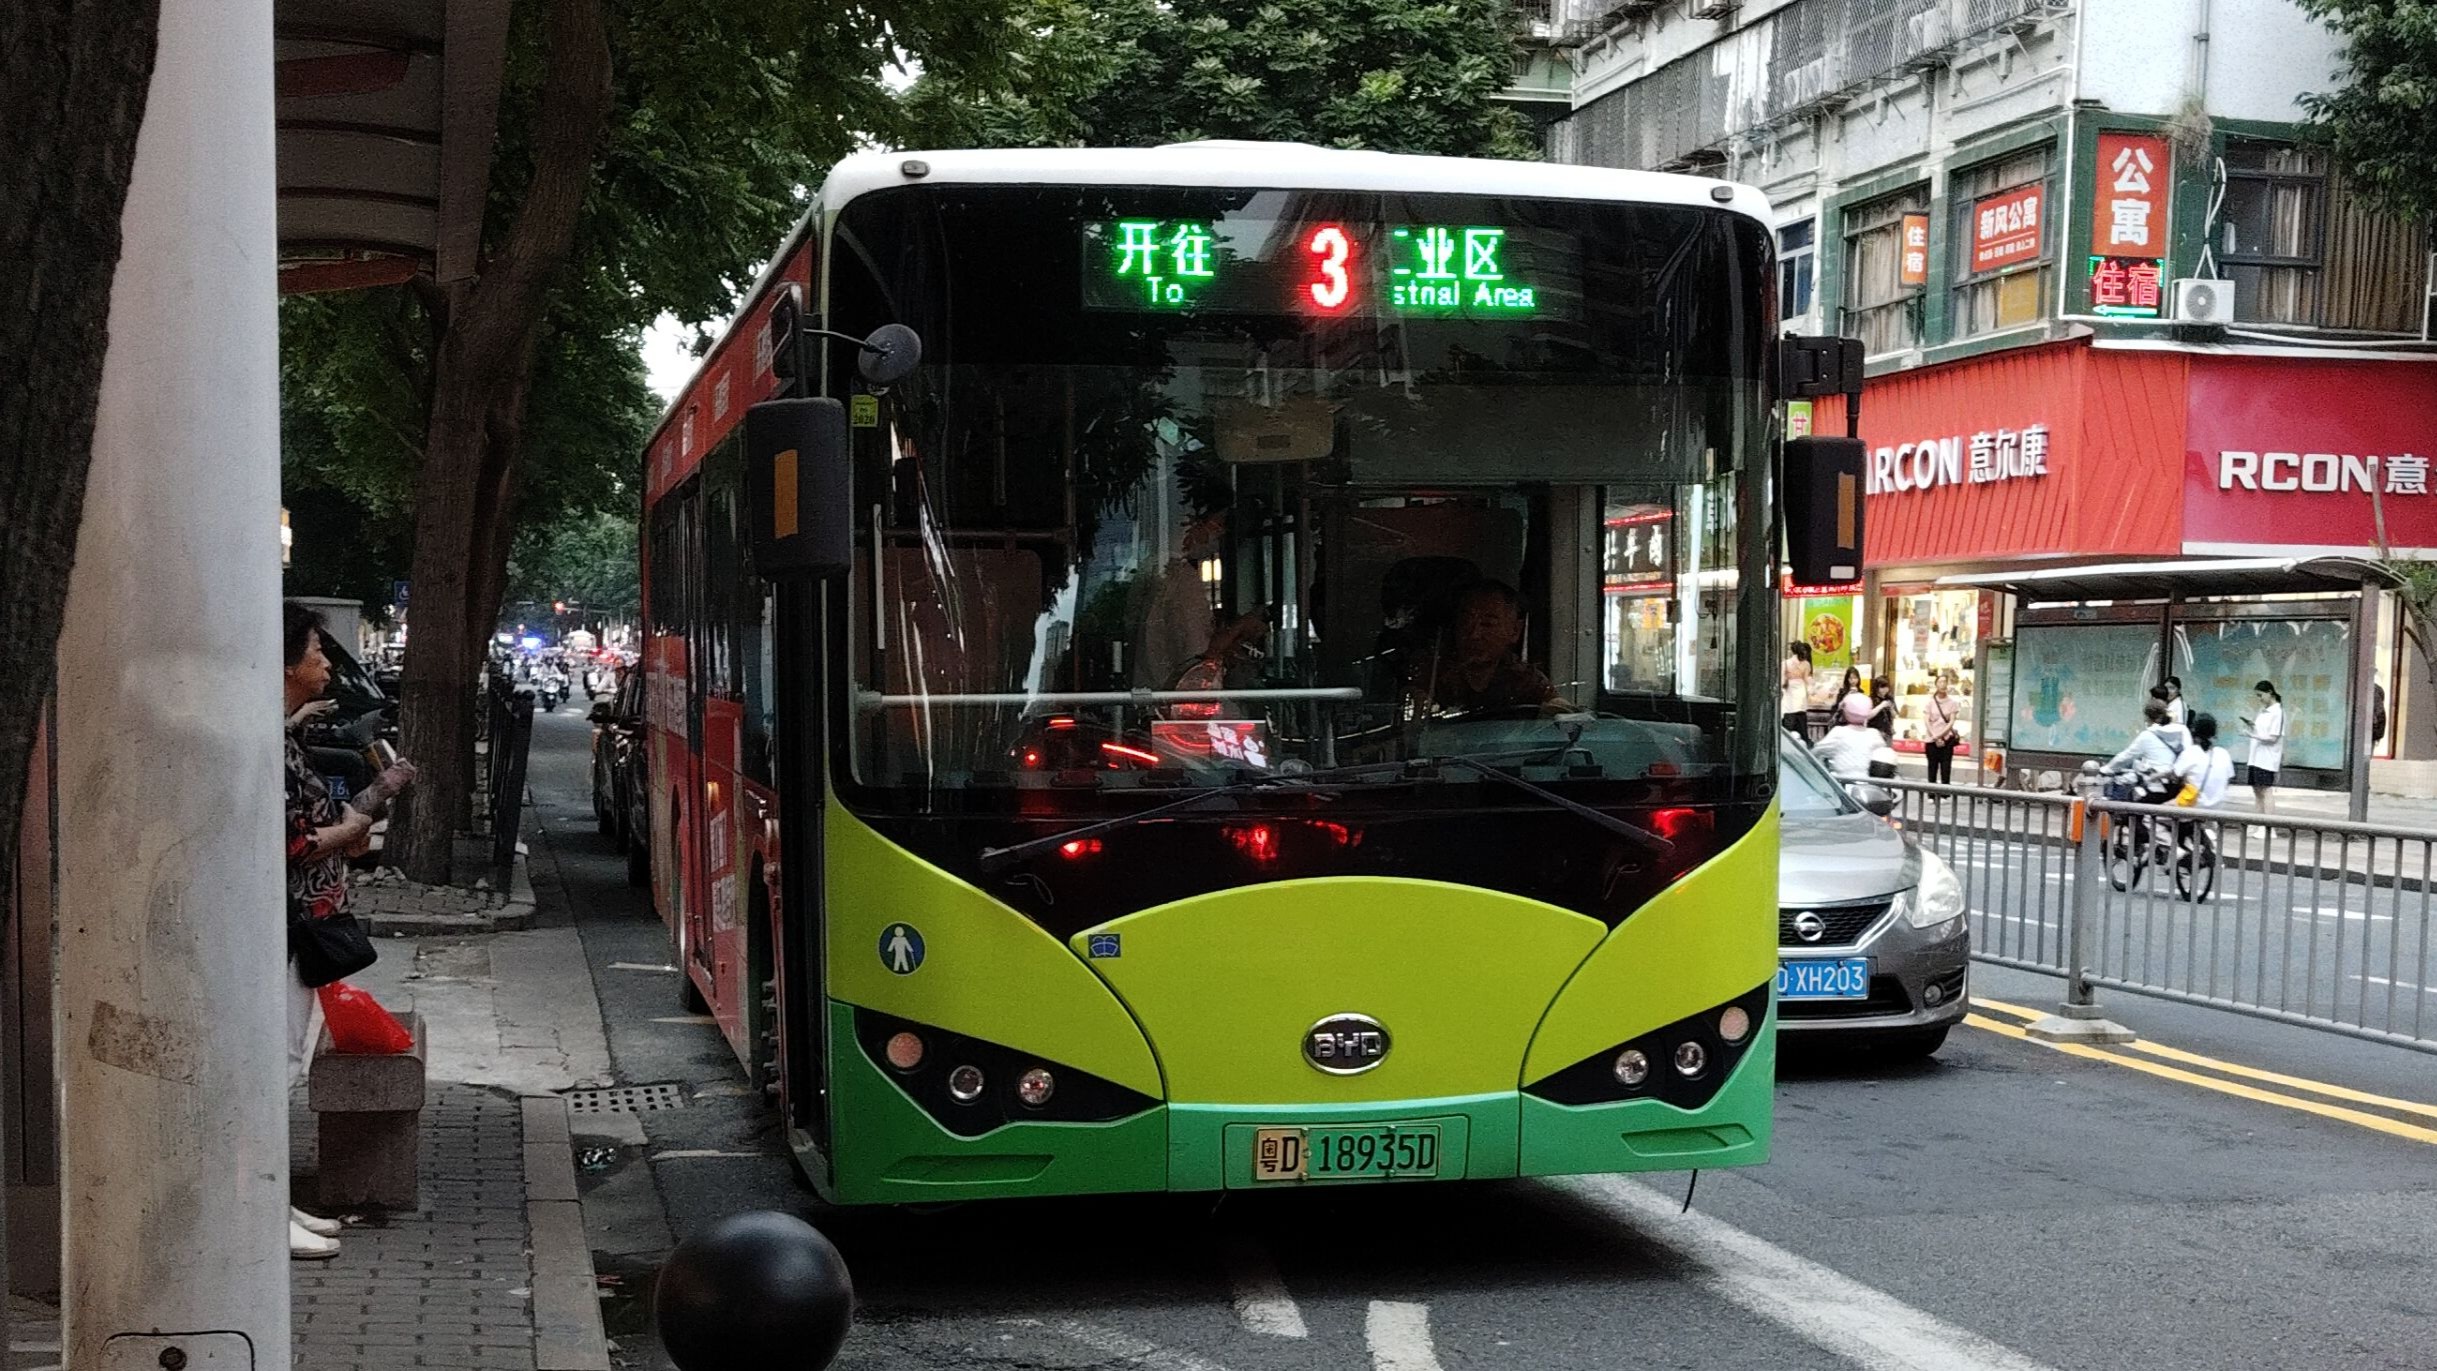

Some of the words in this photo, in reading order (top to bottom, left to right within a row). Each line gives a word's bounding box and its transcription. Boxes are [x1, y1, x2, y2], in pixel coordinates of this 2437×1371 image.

[1980, 196, 2038, 239] 新风公寓
[2111, 147, 2154, 246] 公寓
[1117, 222, 1214, 276] 开往
[1310, 227, 1349, 307] 3
[1906, 226, 1925, 273] 住宿
[1146, 276, 1184, 303] To
[1473, 281, 1535, 307] Area
[2093, 261, 2159, 305] 住宿
[1968, 422, 2048, 483] 意尔康
[2219, 450, 2379, 492] RCON
[1314, 1031, 1382, 1058] BYD
[1318, 1133, 1436, 1172] 18935D
